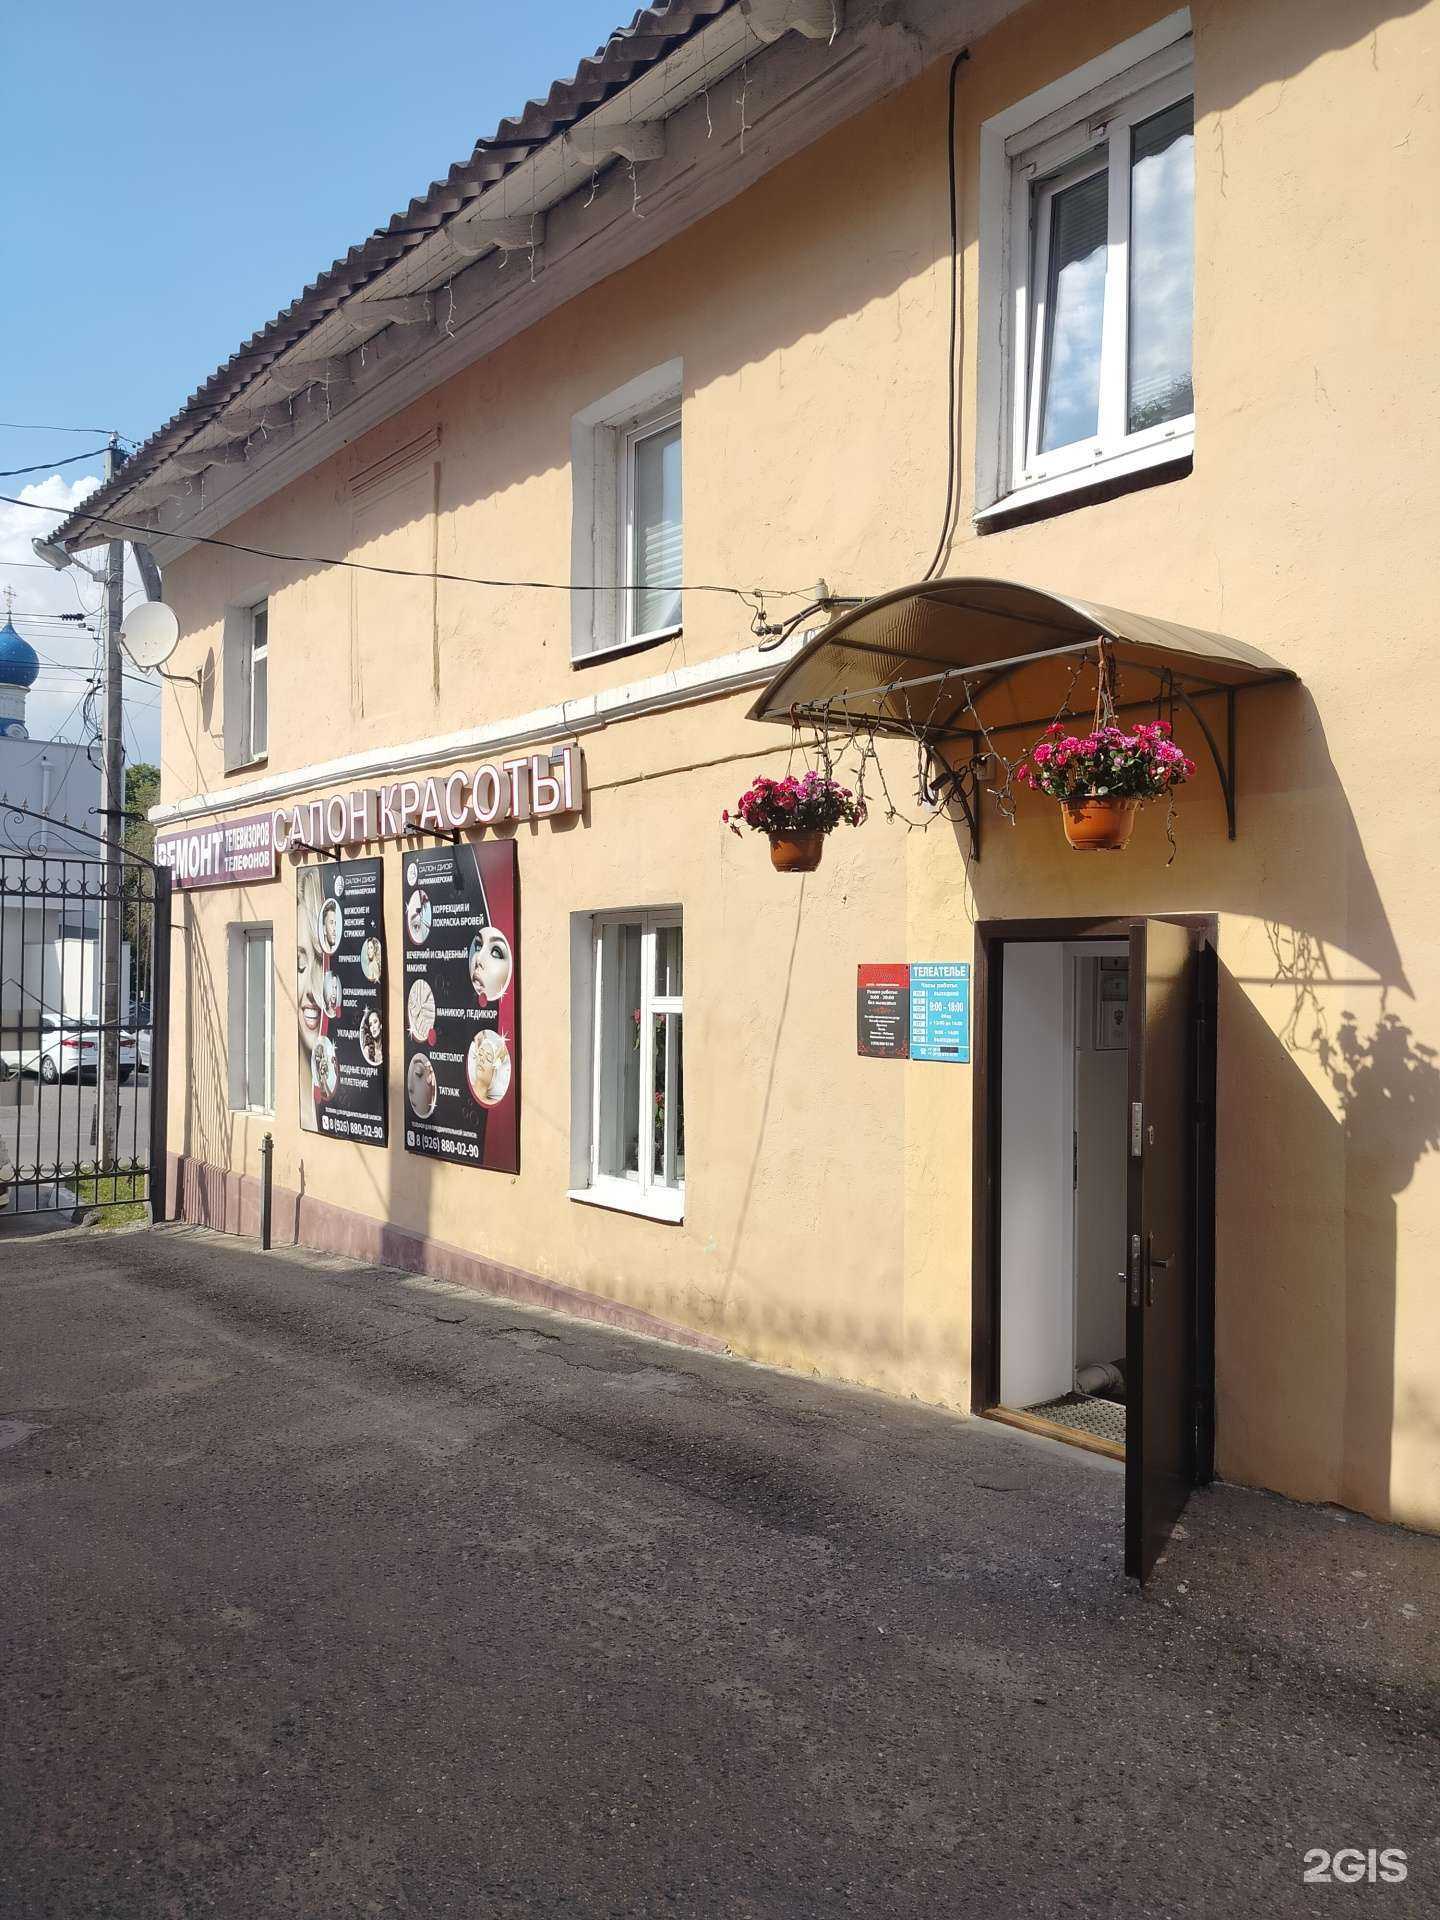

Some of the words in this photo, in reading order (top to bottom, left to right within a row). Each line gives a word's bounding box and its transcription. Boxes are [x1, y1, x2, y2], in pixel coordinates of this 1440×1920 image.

[272, 790, 369, 854] САЛОН
[379, 747, 573, 834] КРАСОТЫ
[225, 822, 269, 852] ТЕЛЕВИЗОРОВ
[224, 851, 269, 872] ТЕЛЕФОНОВ
[433, 904, 465, 914] КОРРЕКЦИЯ
[433, 918, 460, 927] ПОКРАСКА
[460, 914, 484, 926] БРОВЕЙ
[407, 948, 430, 959] ВЕЧЕРНИЙ
[434, 947, 468, 961] СВАДЕБНЫЙ
[407, 964, 427, 972] МАКИЯЖ
[913, 966, 966, 977] ТЕЛЕАТЕЛЬЕ
[437, 1007, 466, 1019] МАНИКЮР,
[466, 1010, 498, 1020] ПЕДИКЮР
[429, 1052, 464, 1062] КОСМЕТОЛОГ
[361, 1066, 378, 1077] КУДРИ
[438, 1086, 460, 1097] ТАТУАЖ
[329, 1118, 334, 1130] 8
[416, 1134, 421, 1146] 8
[421, 1134, 440, 1152] (926)
[441, 1139, 479, 1158] 880-02-90
